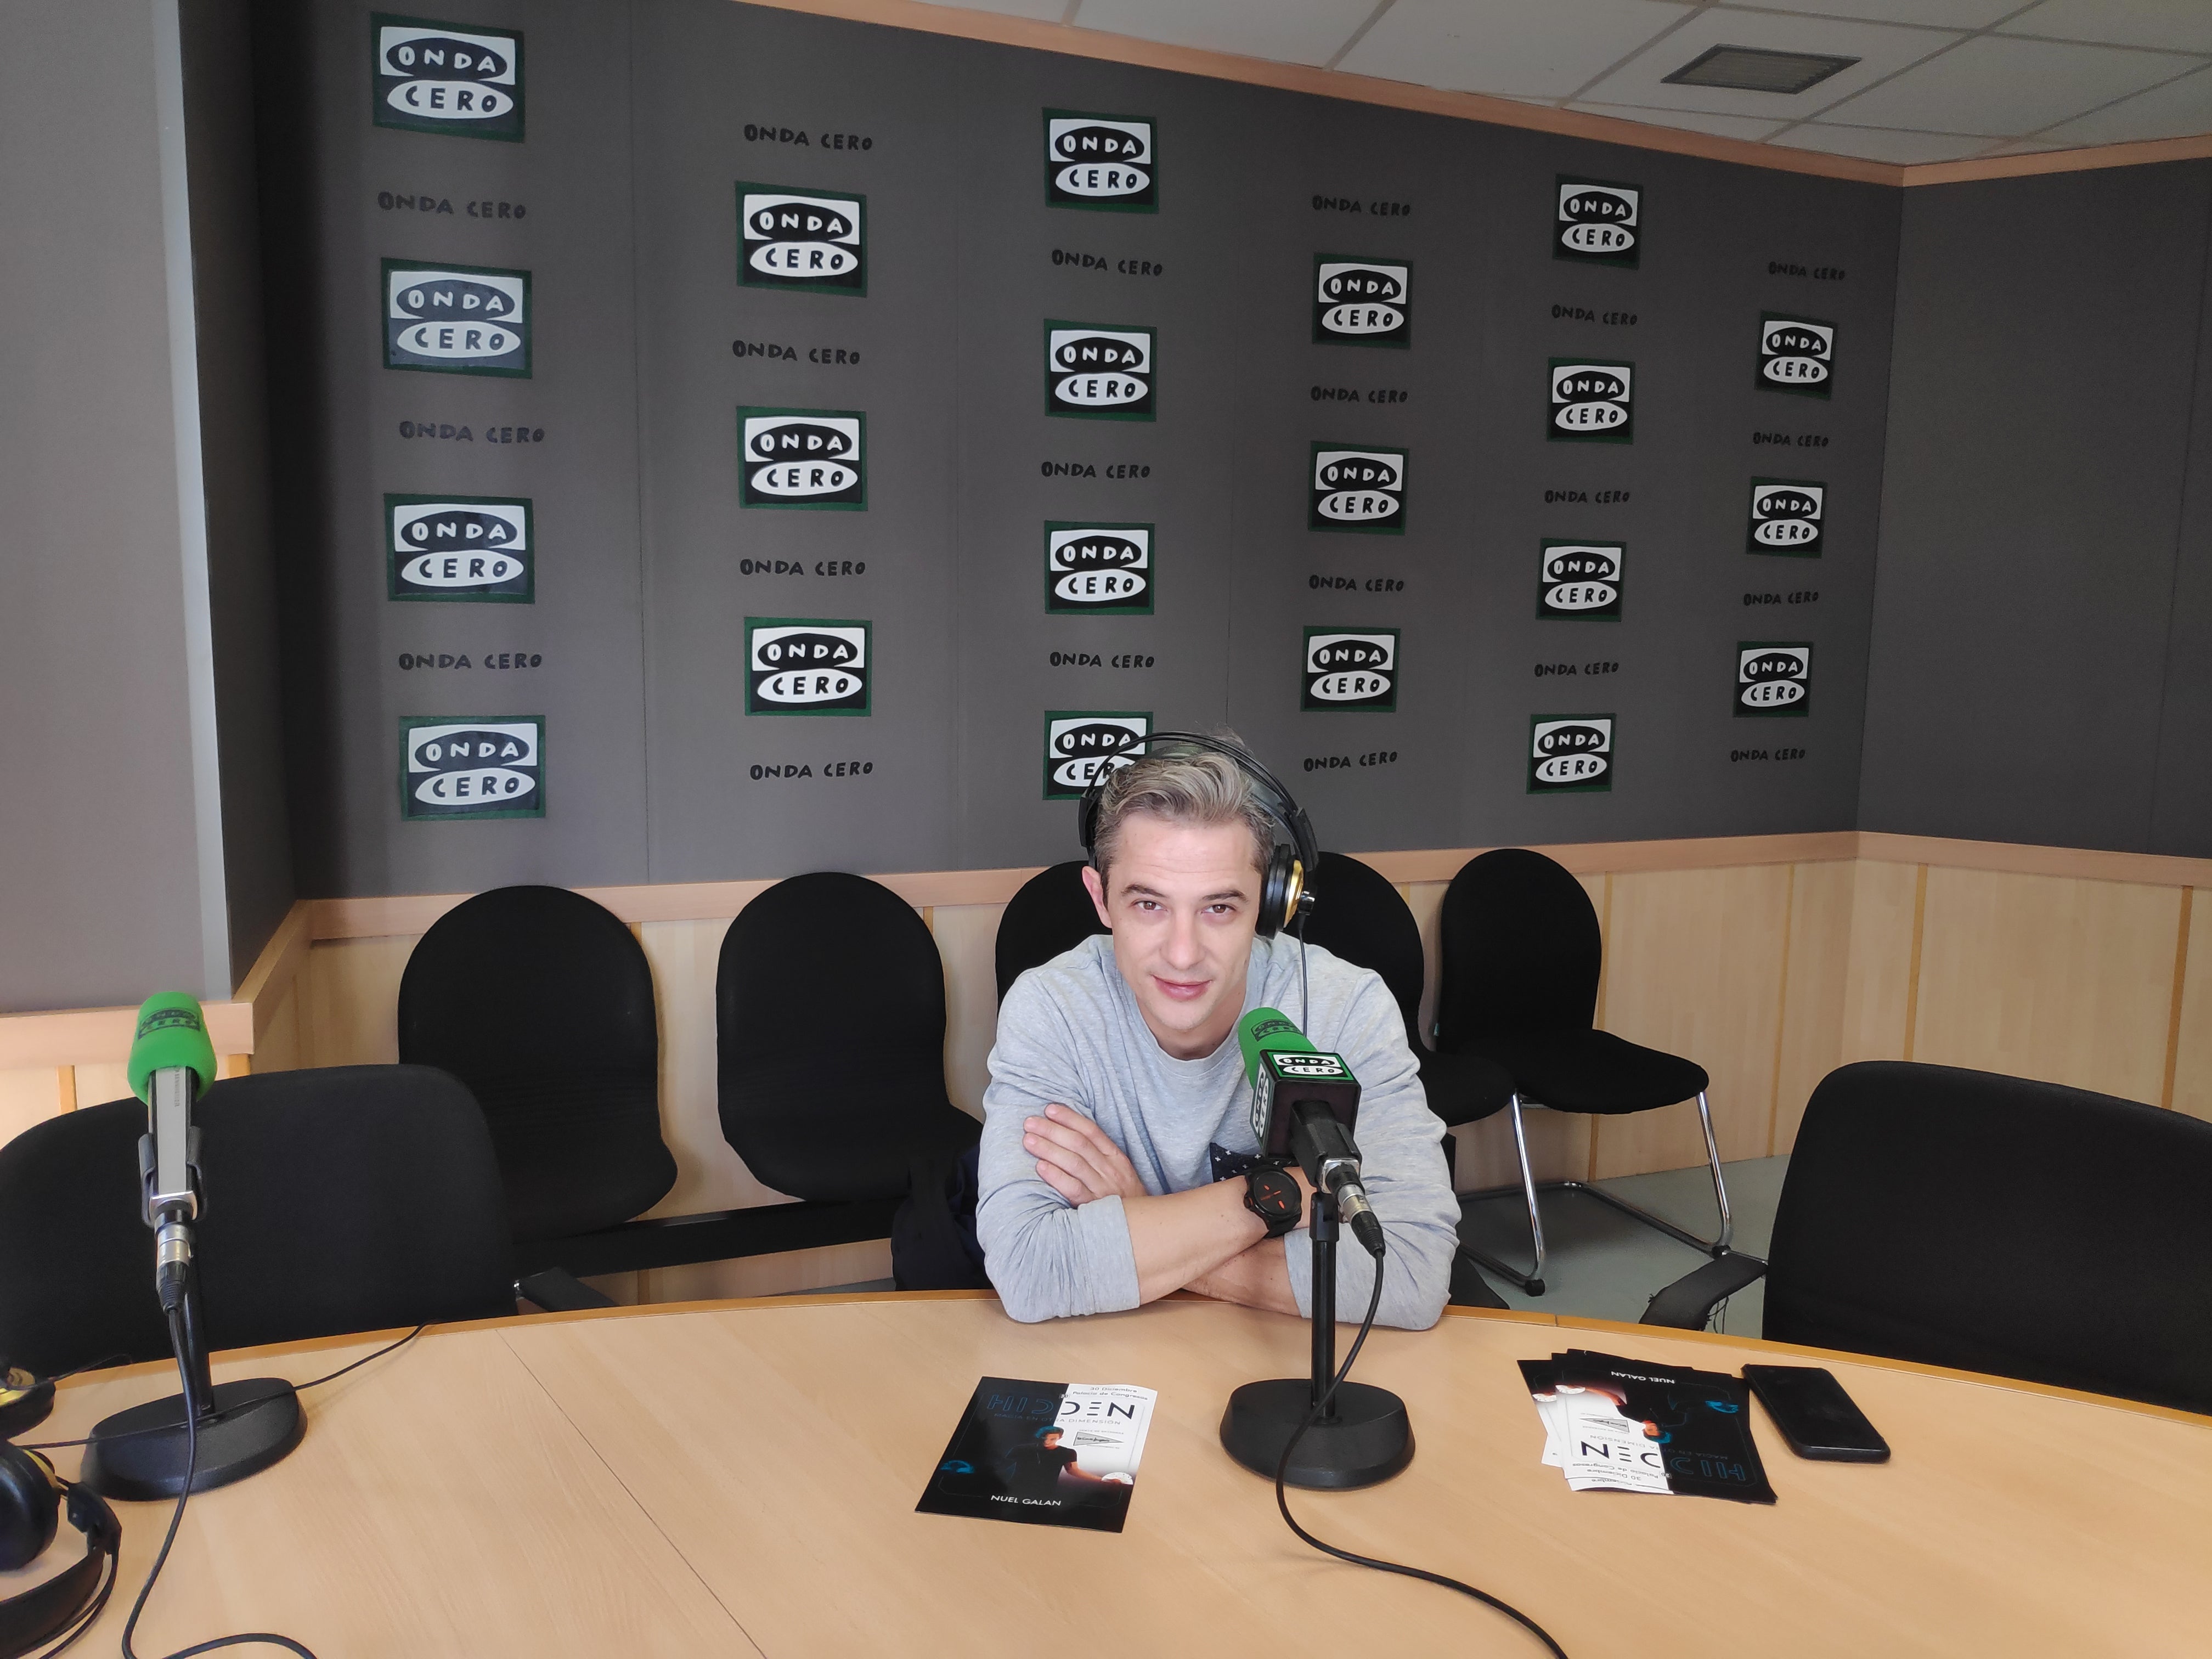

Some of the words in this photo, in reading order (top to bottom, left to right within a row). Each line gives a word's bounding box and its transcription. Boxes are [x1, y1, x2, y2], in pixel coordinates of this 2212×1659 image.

[398, 46, 496, 72] ONDA
[405, 86, 497, 112] CERO
[744, 125, 809, 146] ONDA
[821, 134, 872, 150] CERO
[1063, 135, 1136, 154] ONDA
[1069, 169, 1137, 189] CERO
[378, 191, 454, 214] ONDA
[467, 201, 526, 219] CERO
[1312, 195, 1361, 213] ONDA
[1370, 202, 1410, 216] CERO
[1570, 199, 1626, 217] ONDA
[759, 212, 843, 234] ONDA
[1572, 228, 1625, 247] CERO
[765, 247, 843, 270] CERO
[1052, 249, 1107, 270] ONDA
[1118, 260, 1163, 276] CERO
[1768, 262, 1807, 277] ONDA
[1814, 268, 1845, 280] CERO
[1330, 278, 1393, 295] ONDA
[408, 290, 504, 312] ONDA
[1334, 309, 1393, 327] CERO
[1551, 304, 1594, 322] ONDA
[1603, 313, 1637, 325] CERO
[415, 327, 504, 351] CERO
[1772, 334, 1821, 351] ONDA
[732, 340, 797, 361] ONDA
[809, 348, 860, 364] CERO
[1063, 346, 1136, 364] ONDA
[1773, 360, 1820, 379] CERO
[1068, 379, 1136, 398] CERO
[1311, 386, 1359, 402] ONDA
[1368, 390, 1408, 403] CERO
[1562, 380, 1618, 394] ONDA
[1566, 408, 1618, 424] CERO
[399, 421, 473, 442] ONDA
[486, 427, 545, 443] CERO
[1753, 432, 1791, 445] ONDA
[1797, 435, 1829, 447] CERO
[760, 433, 843, 452] ONDA
[766, 468, 844, 488] CERO
[1041, 461, 1096, 477] ONDA
[1107, 465, 1150, 478] CERO
[1327, 466, 1390, 482] ONDA
[1329, 496, 1389, 514] CERO
[1545, 490, 1587, 503] ONDA
[1595, 491, 1629, 503] CERO
[1762, 498, 1812, 512] ONDA
[411, 522, 507, 541] ONDA
[1763, 524, 1810, 540] CERO
[1063, 545, 1134, 562] ONDA
[419, 558, 507, 578] CERO
[740, 559, 804, 575] ONDA
[815, 561, 865, 576] CERO
[1554, 560, 1609, 574] ONDA
[1068, 577, 1134, 594] CERO
[1309, 575, 1357, 590] ONDA
[1365, 579, 1404, 591] CERO
[1555, 588, 1607, 603] CERO
[1743, 594, 1781, 606] ONDA
[1788, 591, 1819, 603] CERO
[767, 644, 849, 661] ONDA
[1050, 652, 1101, 667] ONDA
[1111, 655, 1154, 668] CERO
[1319, 649, 1381, 664] ONDA
[399, 653, 471, 670] ONDA
[484, 653, 542, 669] CERO
[1534, 664, 1577, 677] ONDA
[1584, 662, 1618, 675] CERO
[1749, 661, 1798, 675] ONDA
[772, 676, 849, 695] CERO
[1322, 677, 1380, 694] CERO
[1750, 686, 1797, 702] CERO
[1063, 733, 1131, 749] ONDA
[1544, 733, 1599, 749] ONDA
[426, 742, 519, 761] ONDA
[1730, 750, 1768, 762] ONDA
[1775, 748, 1805, 760] CERO
[1304, 757, 1351, 772] ONDA
[1359, 752, 1397, 766] CERO
[1546, 760, 1598, 777] CERO
[751, 765, 812, 780] ONDA
[824, 762, 872, 777] CERO
[432, 776, 520, 798] CERO
[1611, 1370, 1646, 1380] GALAN
[1111, 1392, 1148, 1400] Congresos
[1572, 1462, 1615, 1470] Congresos
[1586, 1469, 1628, 1479] Diciembre
[990, 1495, 1019, 1504] NUEL
